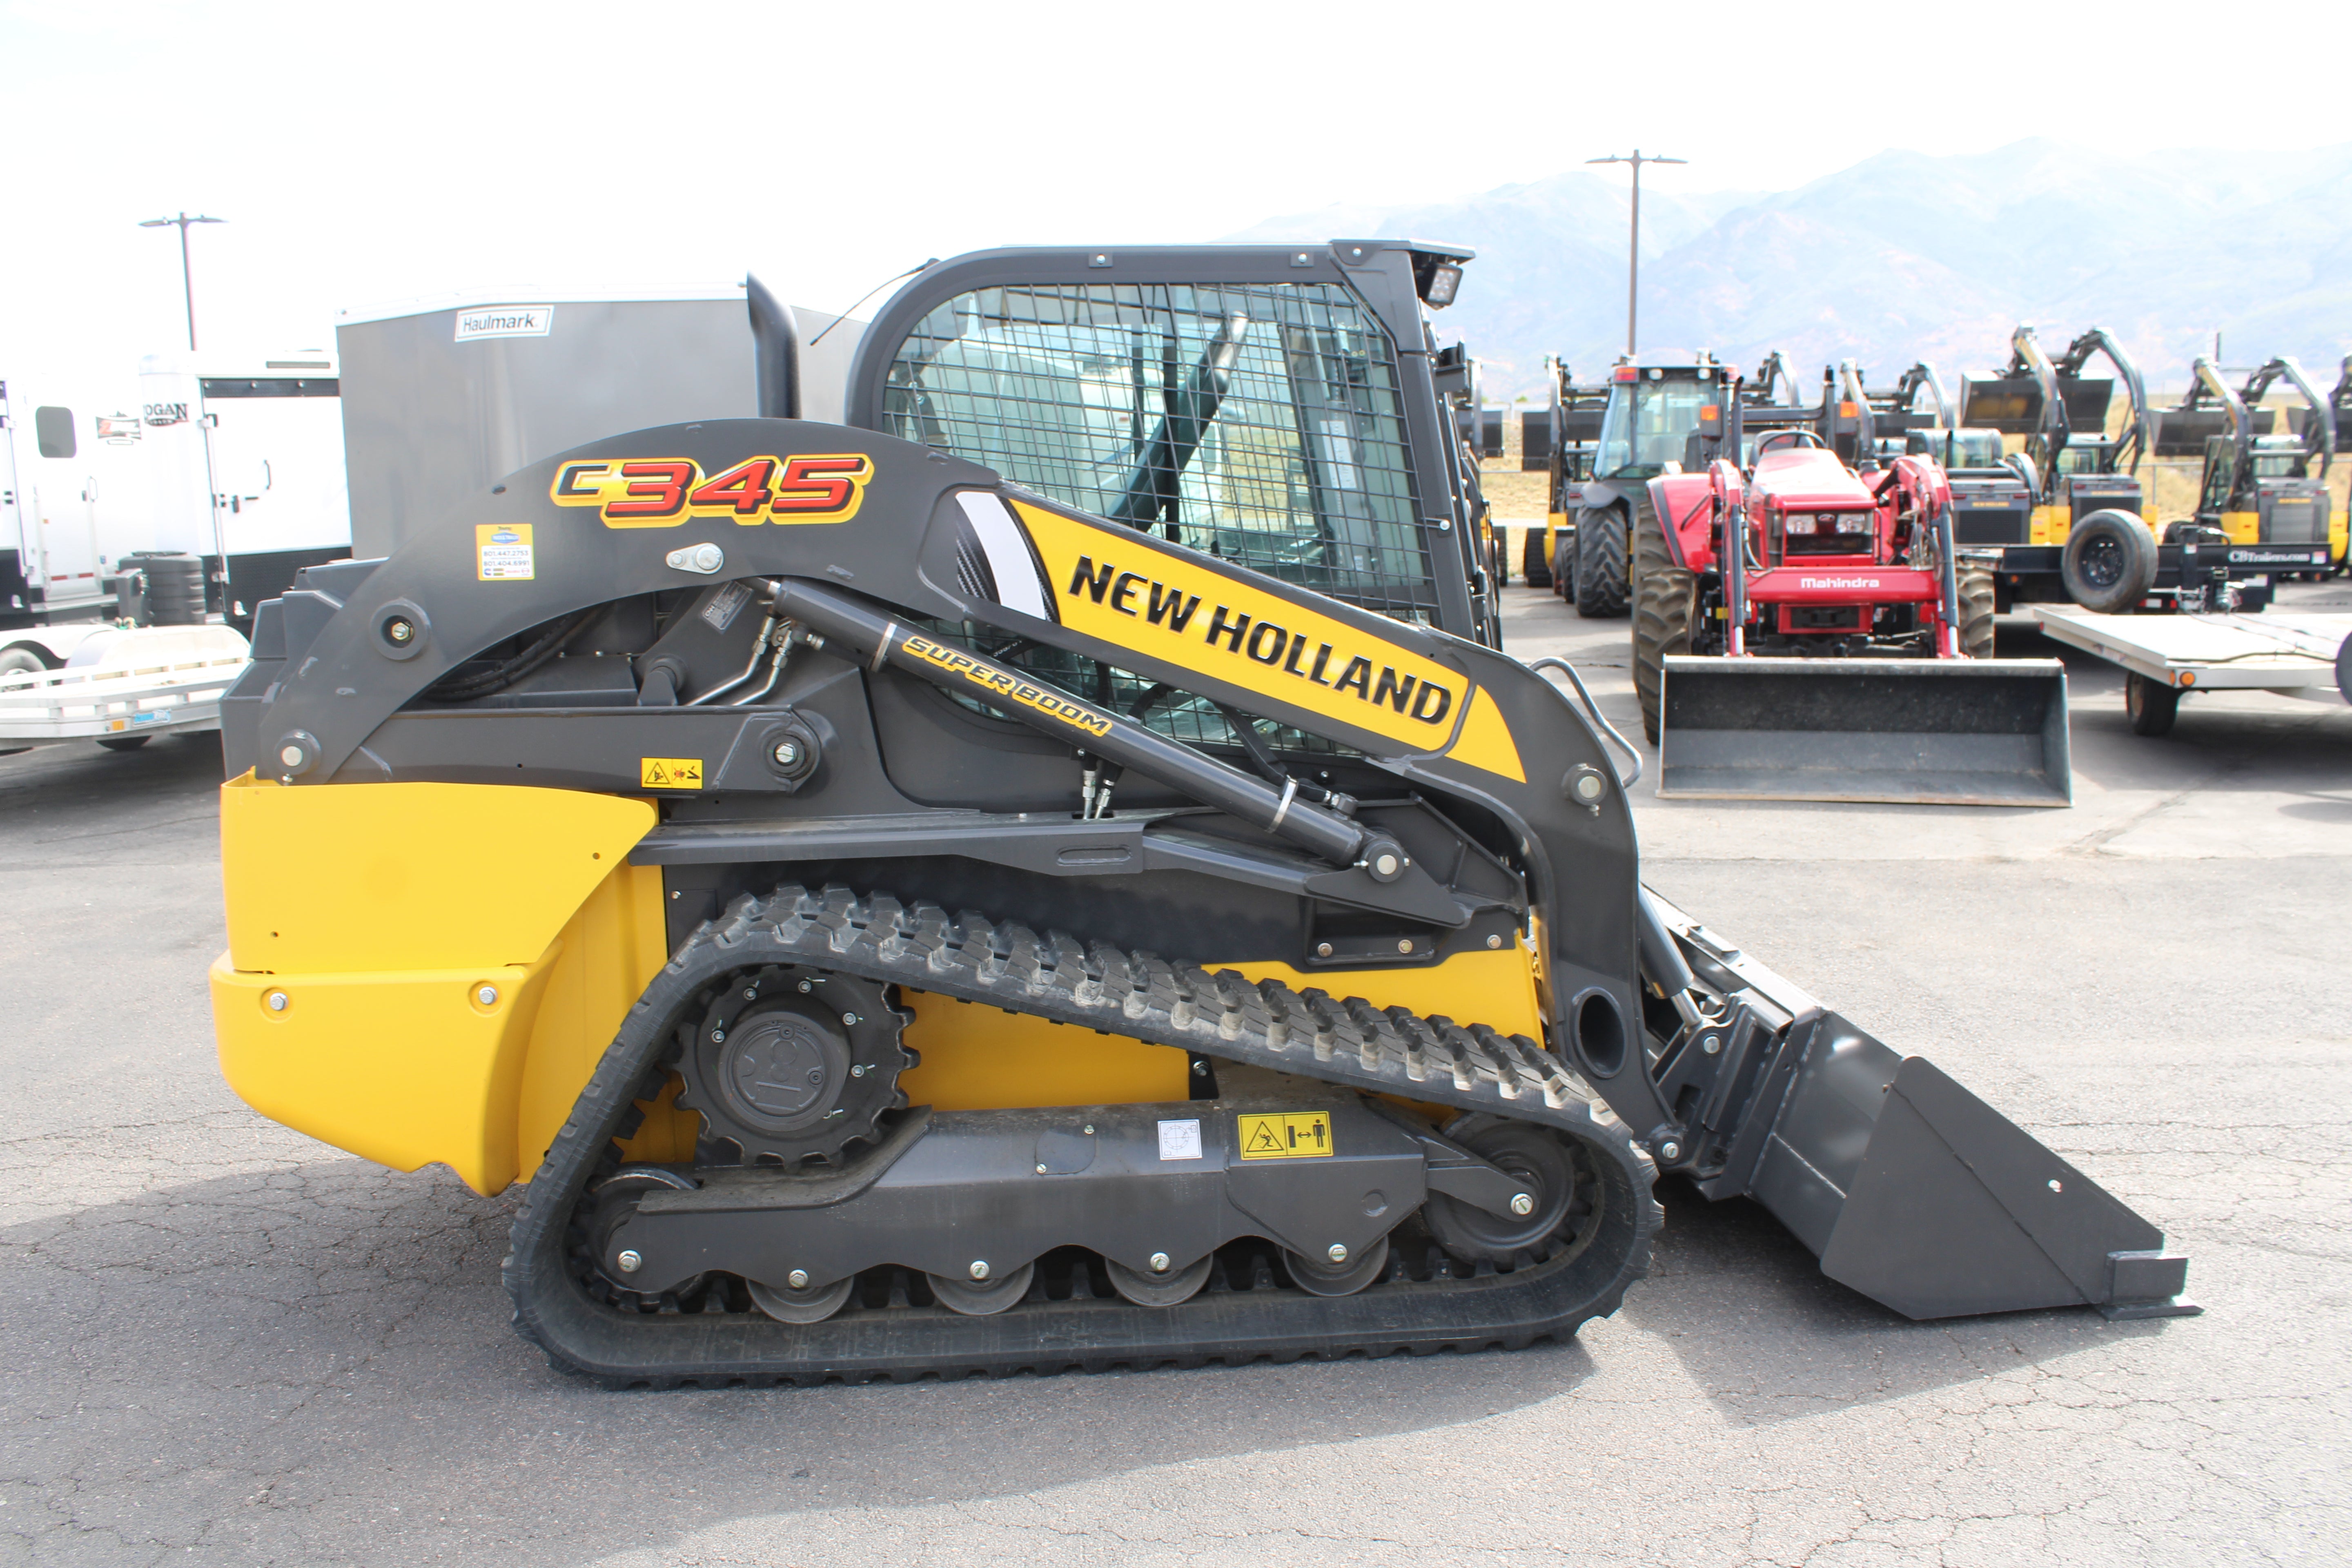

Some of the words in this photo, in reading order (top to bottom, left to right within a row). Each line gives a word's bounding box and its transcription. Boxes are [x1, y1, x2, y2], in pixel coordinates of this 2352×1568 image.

[463, 313, 536, 332] Haulmark
[551, 455, 873, 528] C345
[1801, 577, 1880, 588] Mahindra
[1068, 555, 1202, 634] NEW
[1204, 604, 1452, 725] HOLLAND
[902, 636, 1016, 695] SUPER
[1012, 684, 1112, 737] BOOM
